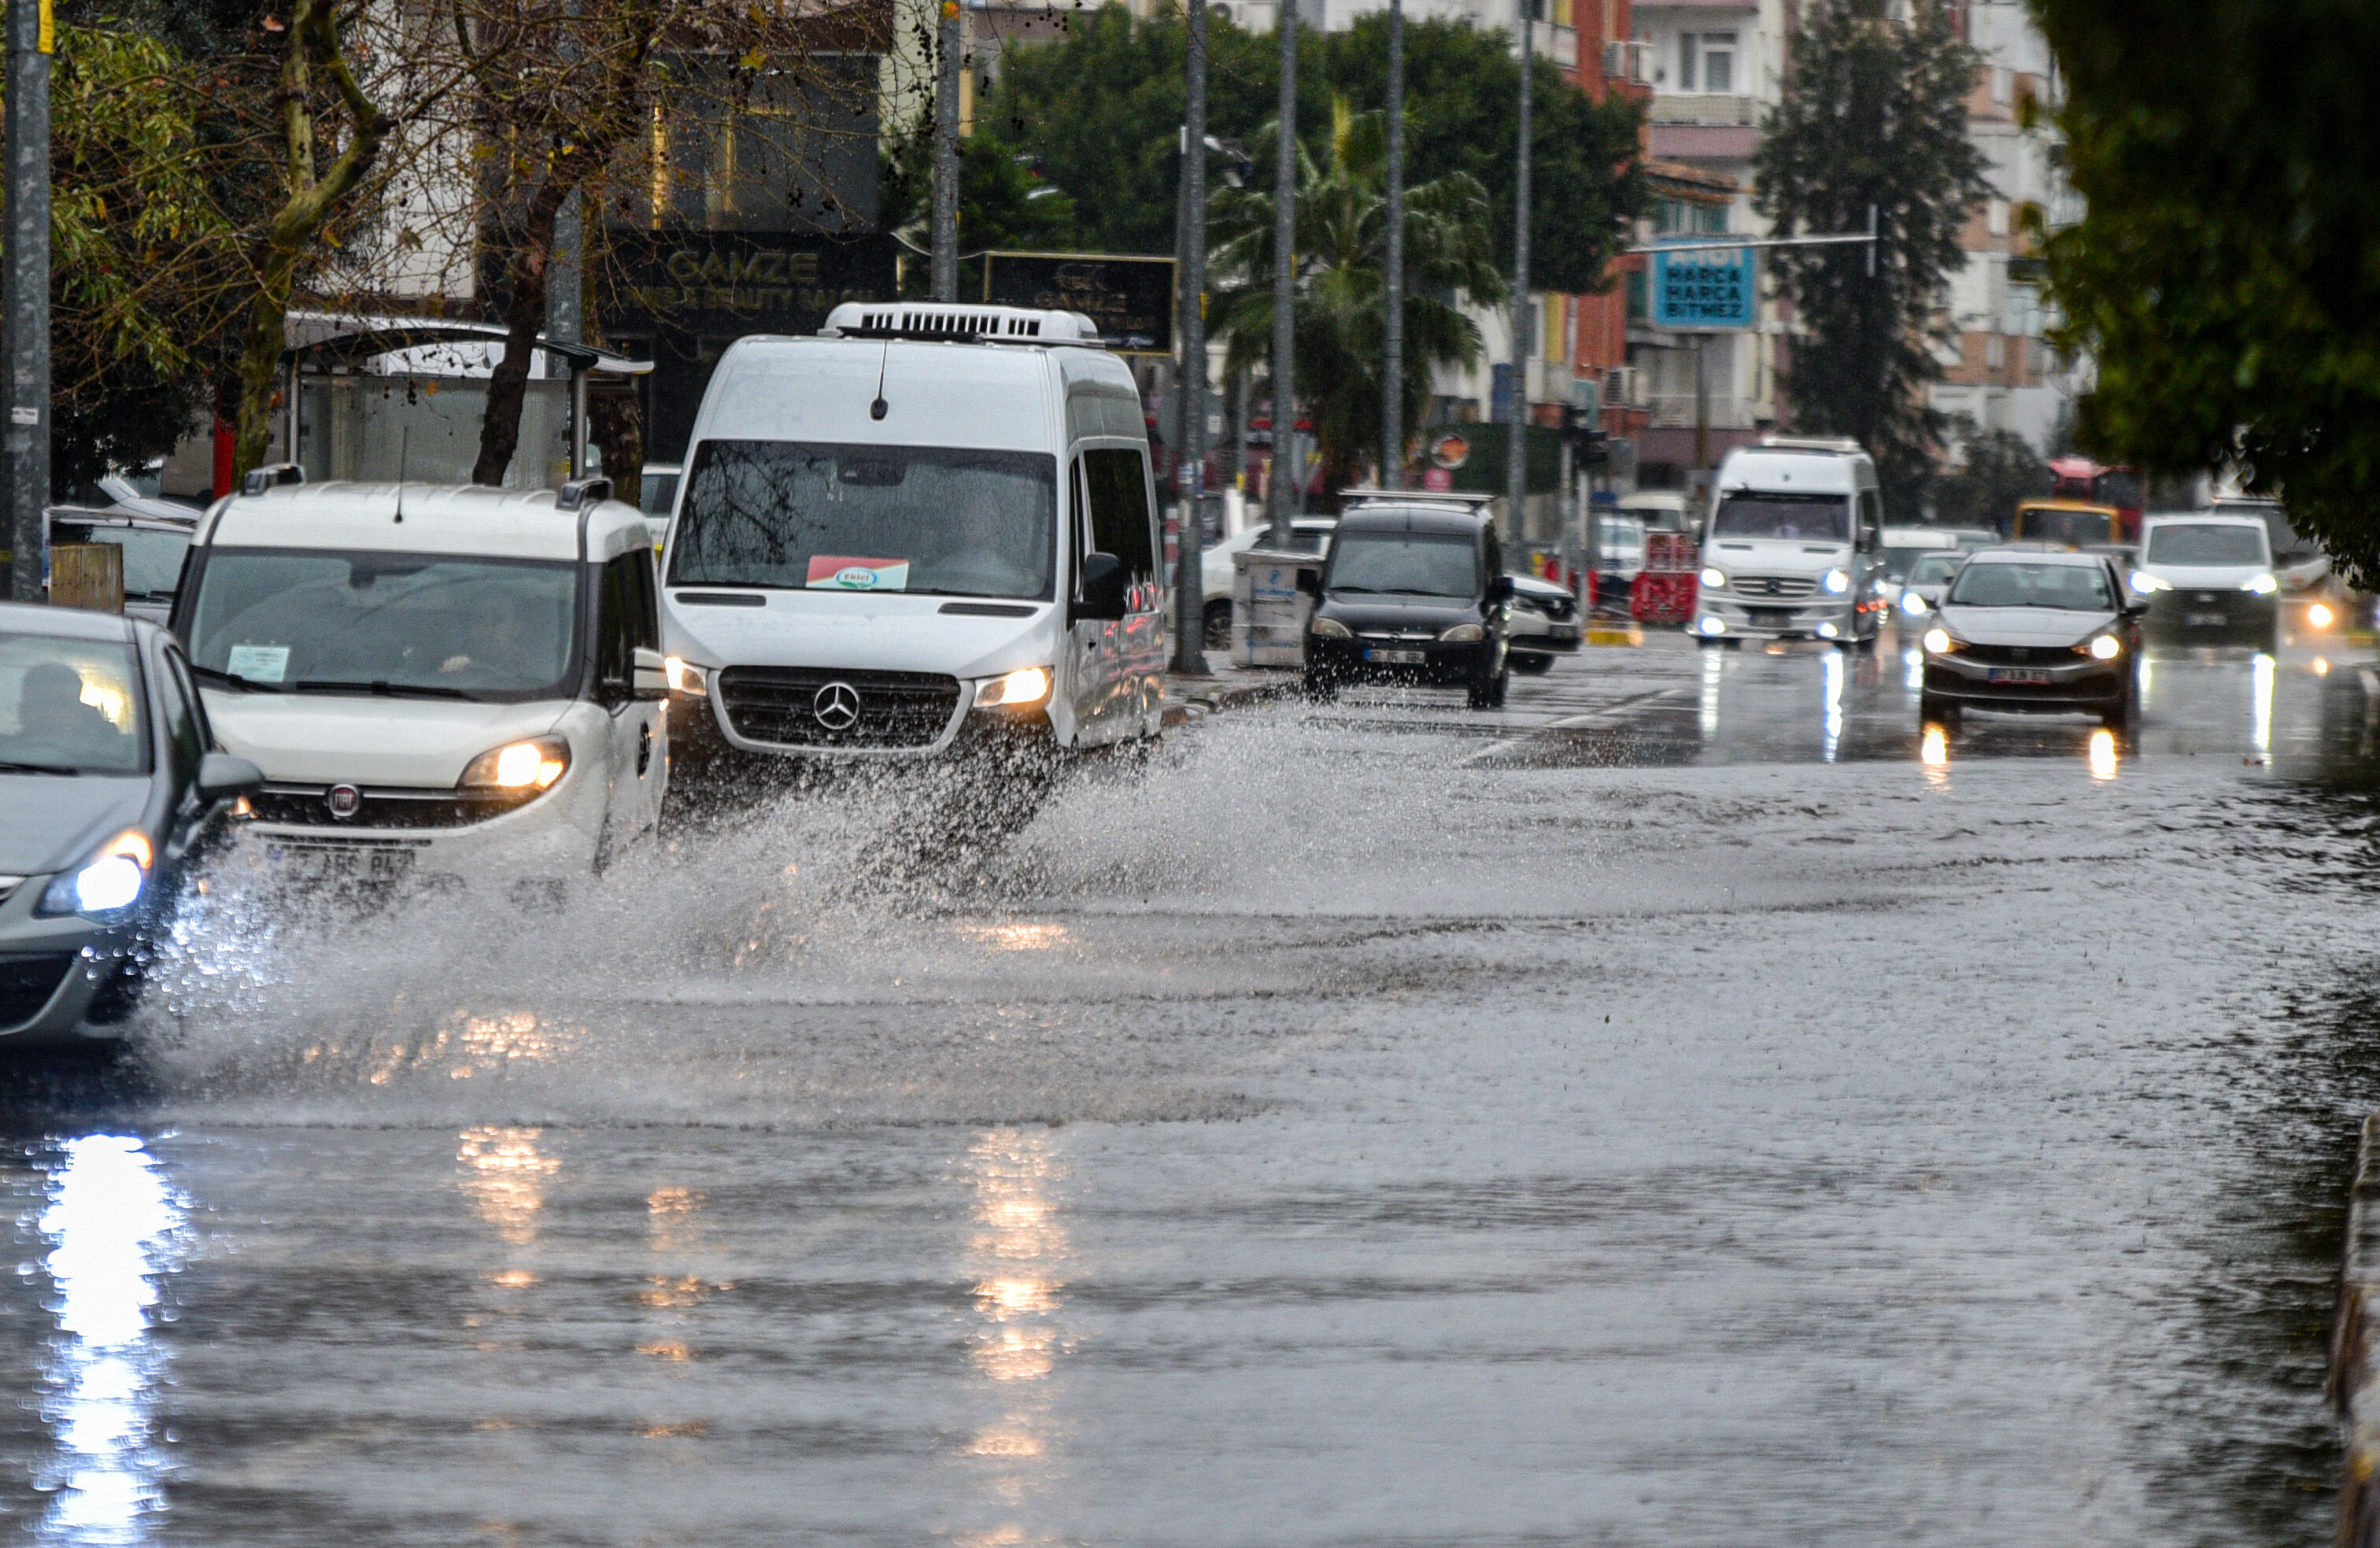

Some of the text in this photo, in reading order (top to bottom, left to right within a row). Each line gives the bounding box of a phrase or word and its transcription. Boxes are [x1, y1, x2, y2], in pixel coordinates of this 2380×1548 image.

[667, 250, 819, 283] GAMZE
[1666, 268, 1741, 284] HARCA
[1666, 285, 1741, 301] HARCA
[334, 793, 354, 808] FIAT
